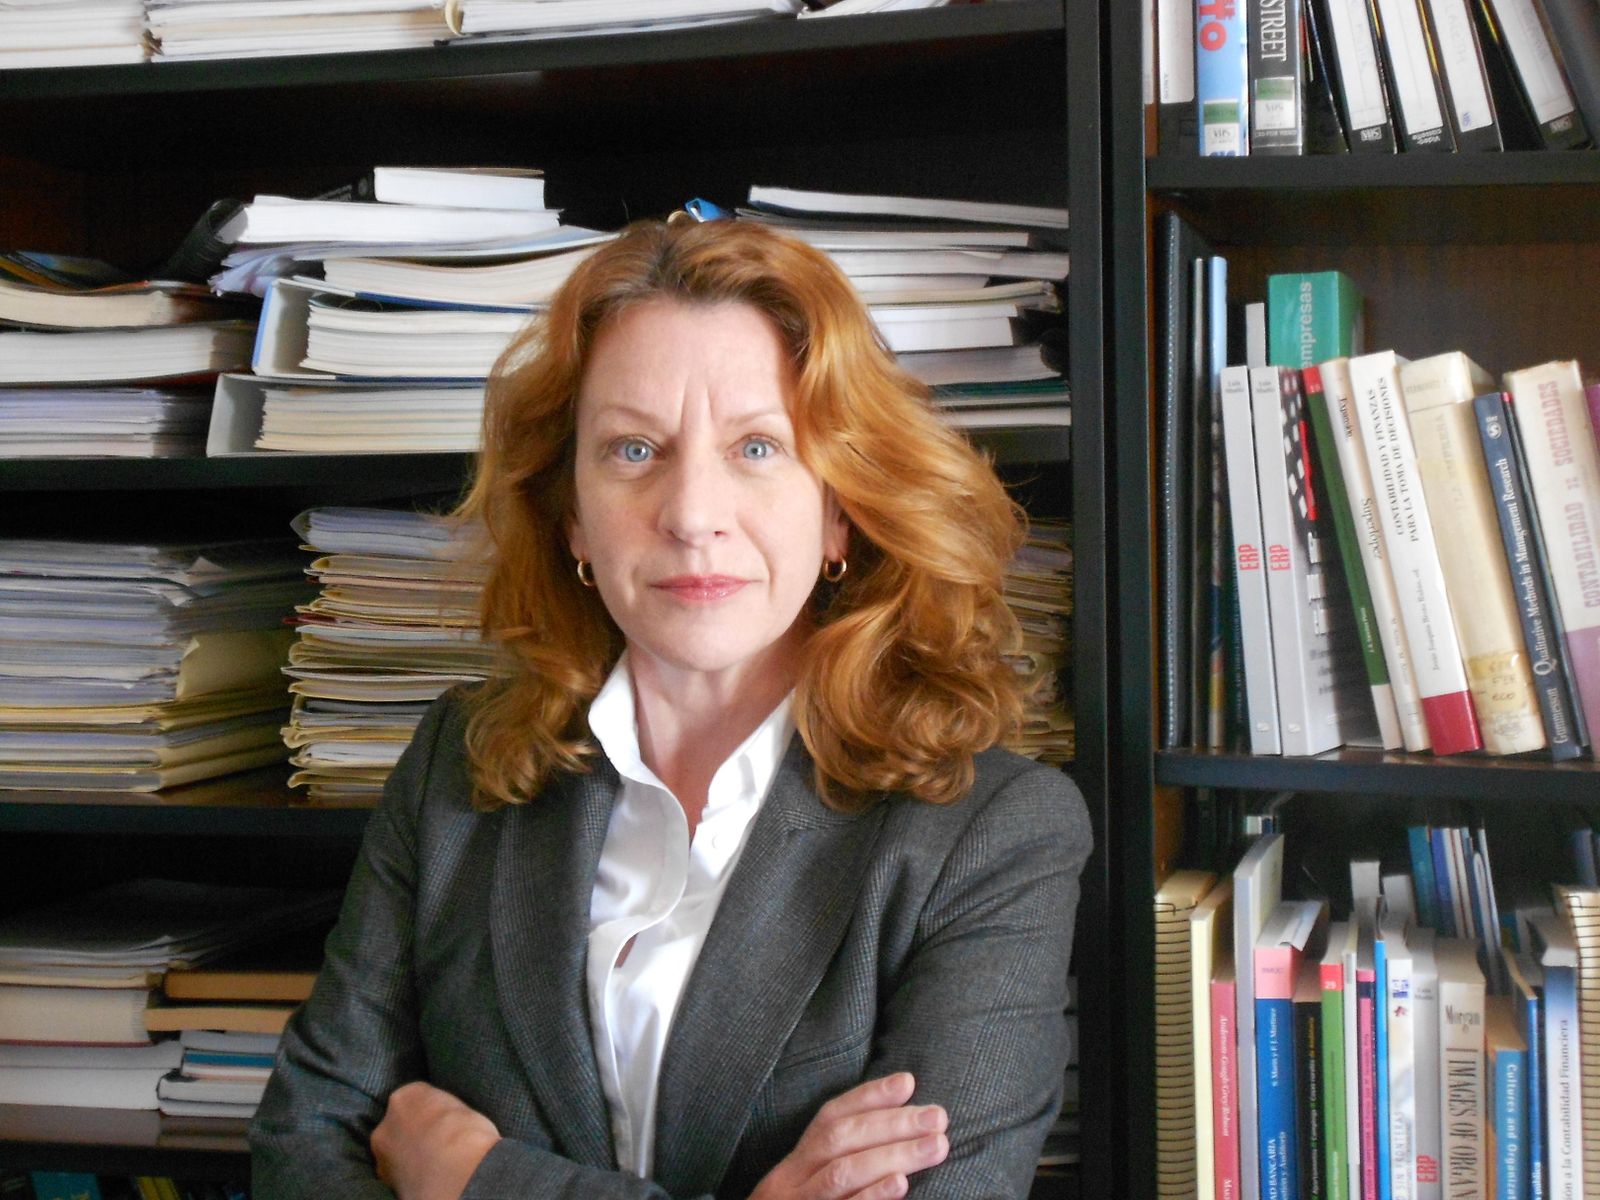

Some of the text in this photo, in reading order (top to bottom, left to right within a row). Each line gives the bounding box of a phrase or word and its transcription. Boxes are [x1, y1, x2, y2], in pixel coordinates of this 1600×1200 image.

[1260, 0, 1287, 62] STREET
[1367, 389, 1385, 441] FINANZAS
[1537, 379, 1574, 467] SOCIEDADES
[1377, 376, 1419, 542] PARA LA TOMA DE DECISIONES
[1379, 453, 1404, 536] CONTABILIDAD
[1238, 543, 1260, 571] ERP
[1269, 544, 1292, 571] ERP
[1564, 501, 1600, 608] CONTABILIDAD
[1495, 457, 1569, 744] Gummesson Qualitative Methods in Management Research
[1559, 1019, 1570, 1079] Financiera
[1448, 1060, 1479, 1200] IMAGES OF ORGAN
[1505, 1063, 1519, 1200] Cultures and Organizat
[1559, 1081, 1572, 1155] Contabilidad
[1267, 1138, 1277, 1186] BANCARIA
[1416, 1155, 1439, 1184] ERP
[1562, 1158, 1572, 1170] la
